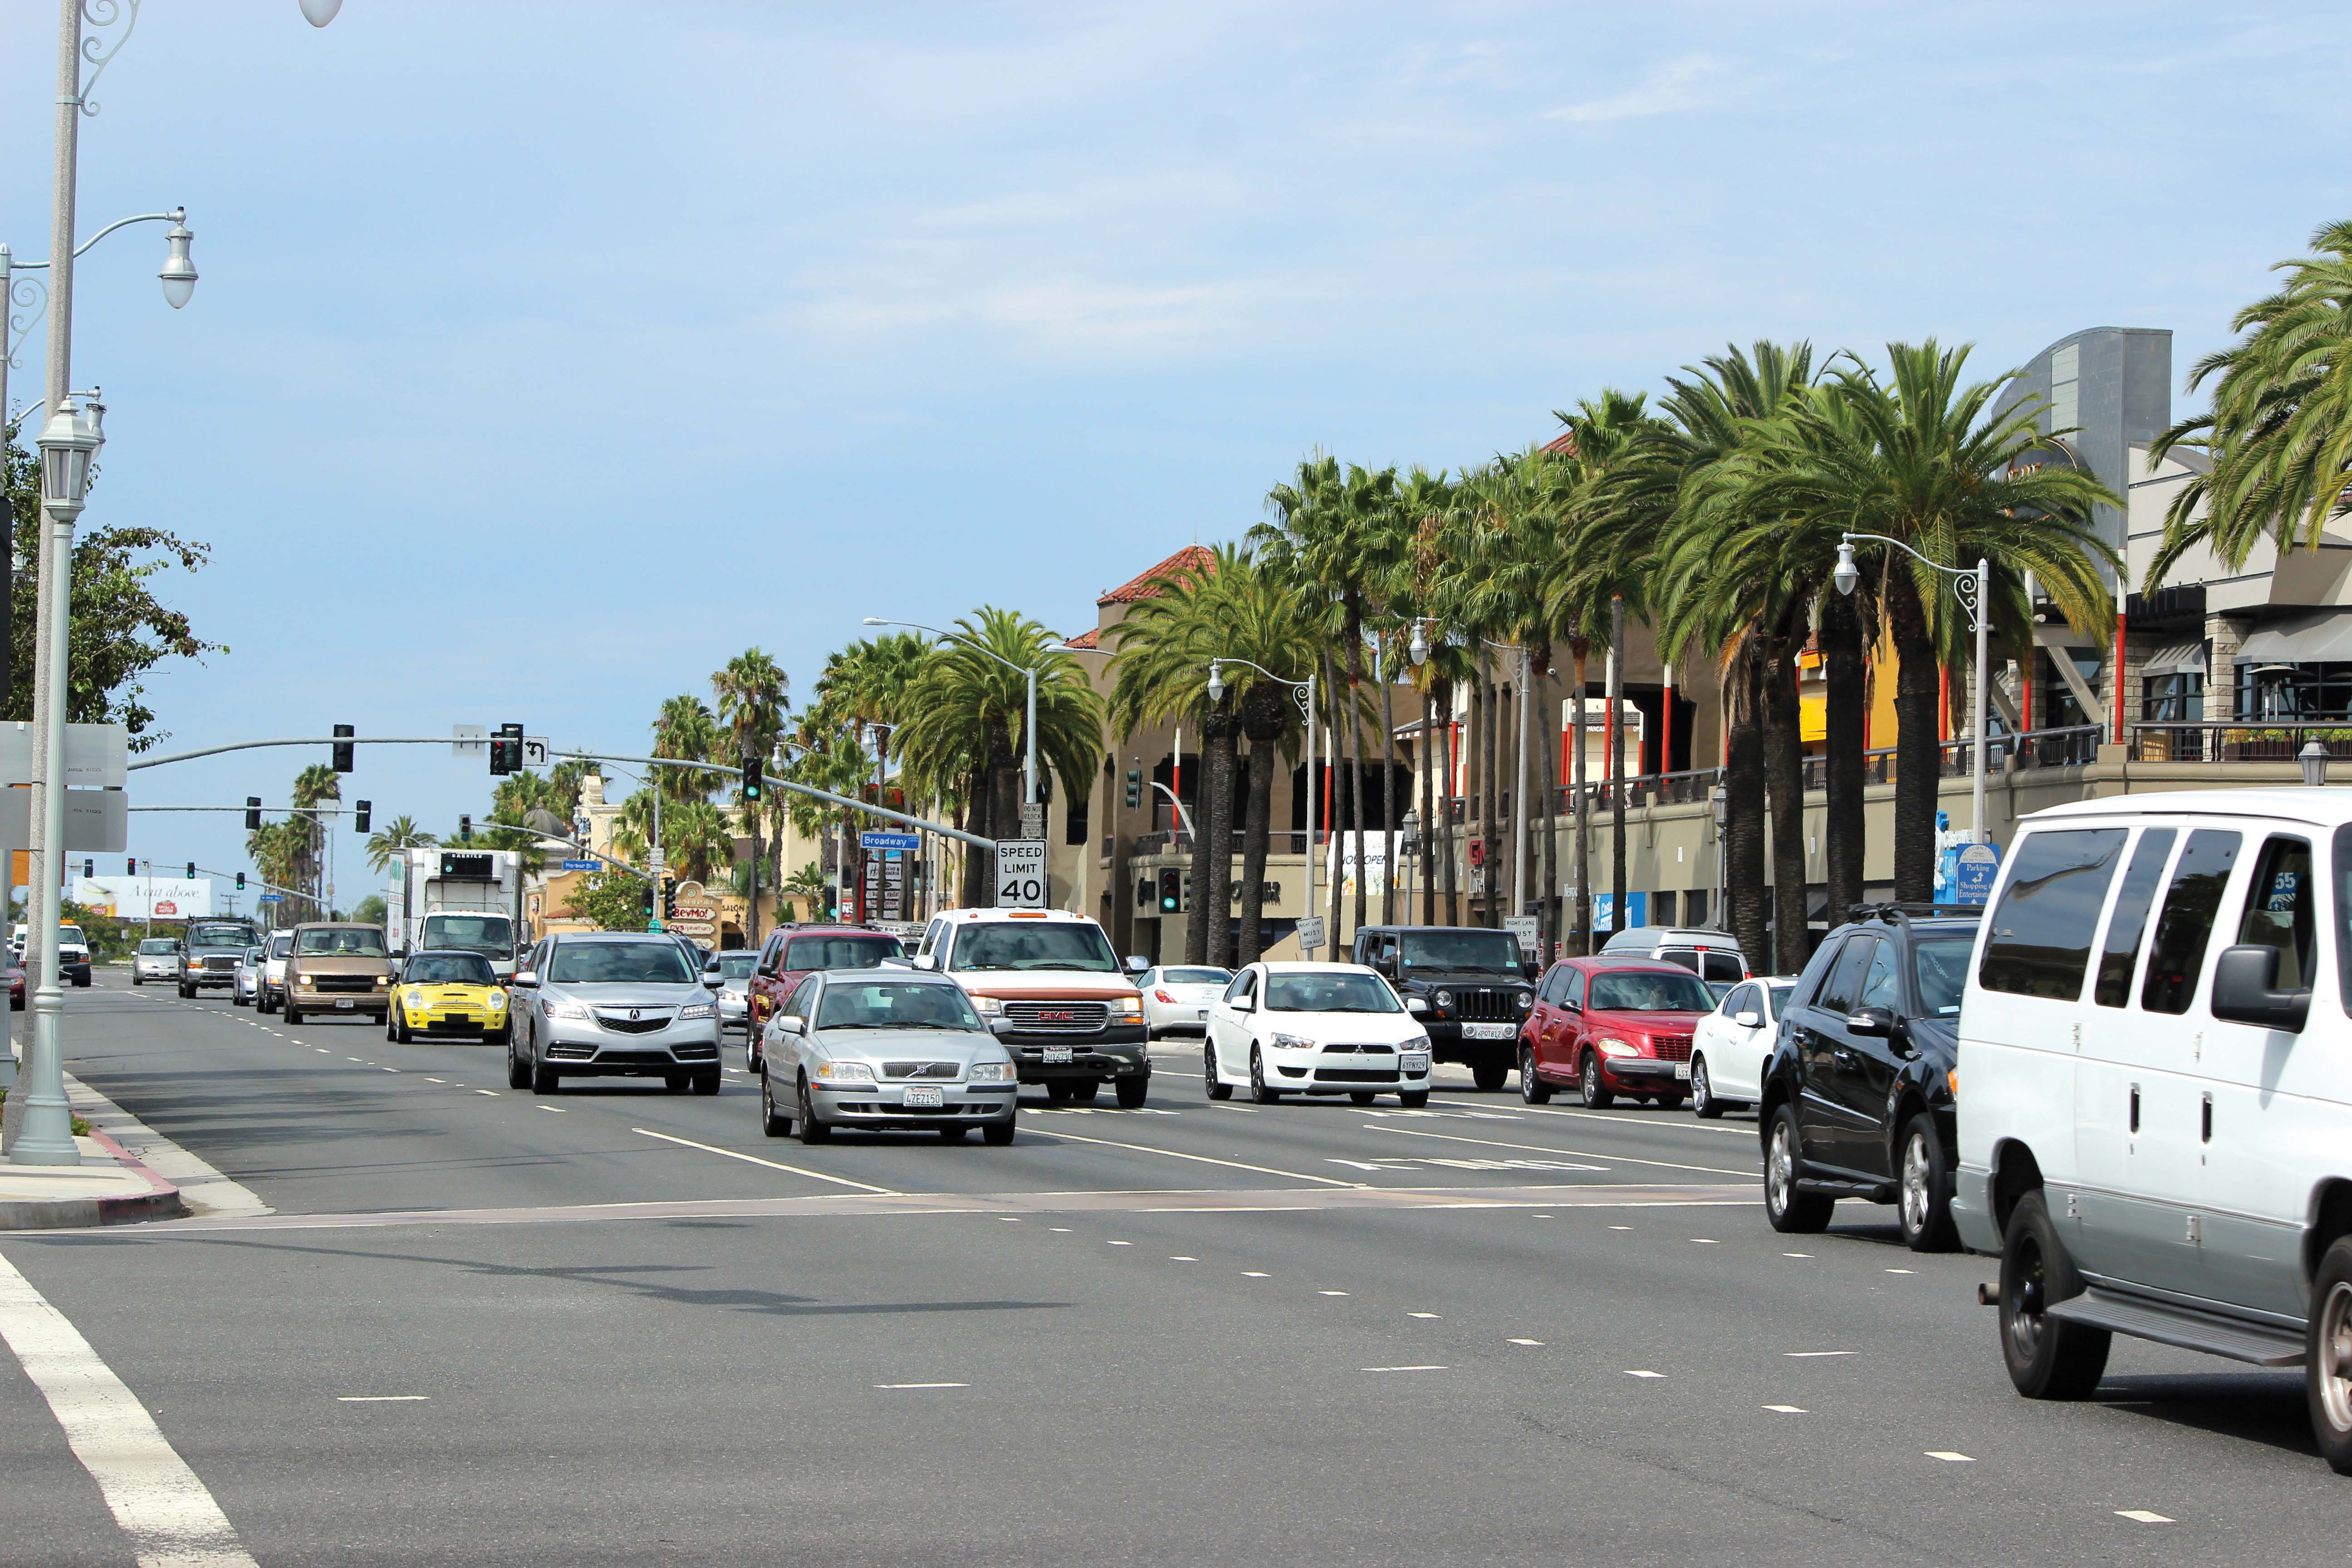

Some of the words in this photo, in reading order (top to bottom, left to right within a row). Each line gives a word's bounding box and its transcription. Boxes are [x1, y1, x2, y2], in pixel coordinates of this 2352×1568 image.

[864, 836, 906, 847] Broadway
[1000, 848, 1042, 857] SPEED
[1004, 864, 1037, 873] LIMIT
[1967, 864, 1989, 872] Parking
[1001, 879, 1040, 901] 40
[1960, 882, 1988, 890] Shopping
[1959, 889, 1989, 898] Entertainm
[1038, 1011, 1074, 1020] GMC
[906, 1094, 940, 1103] 4ZEZ150
